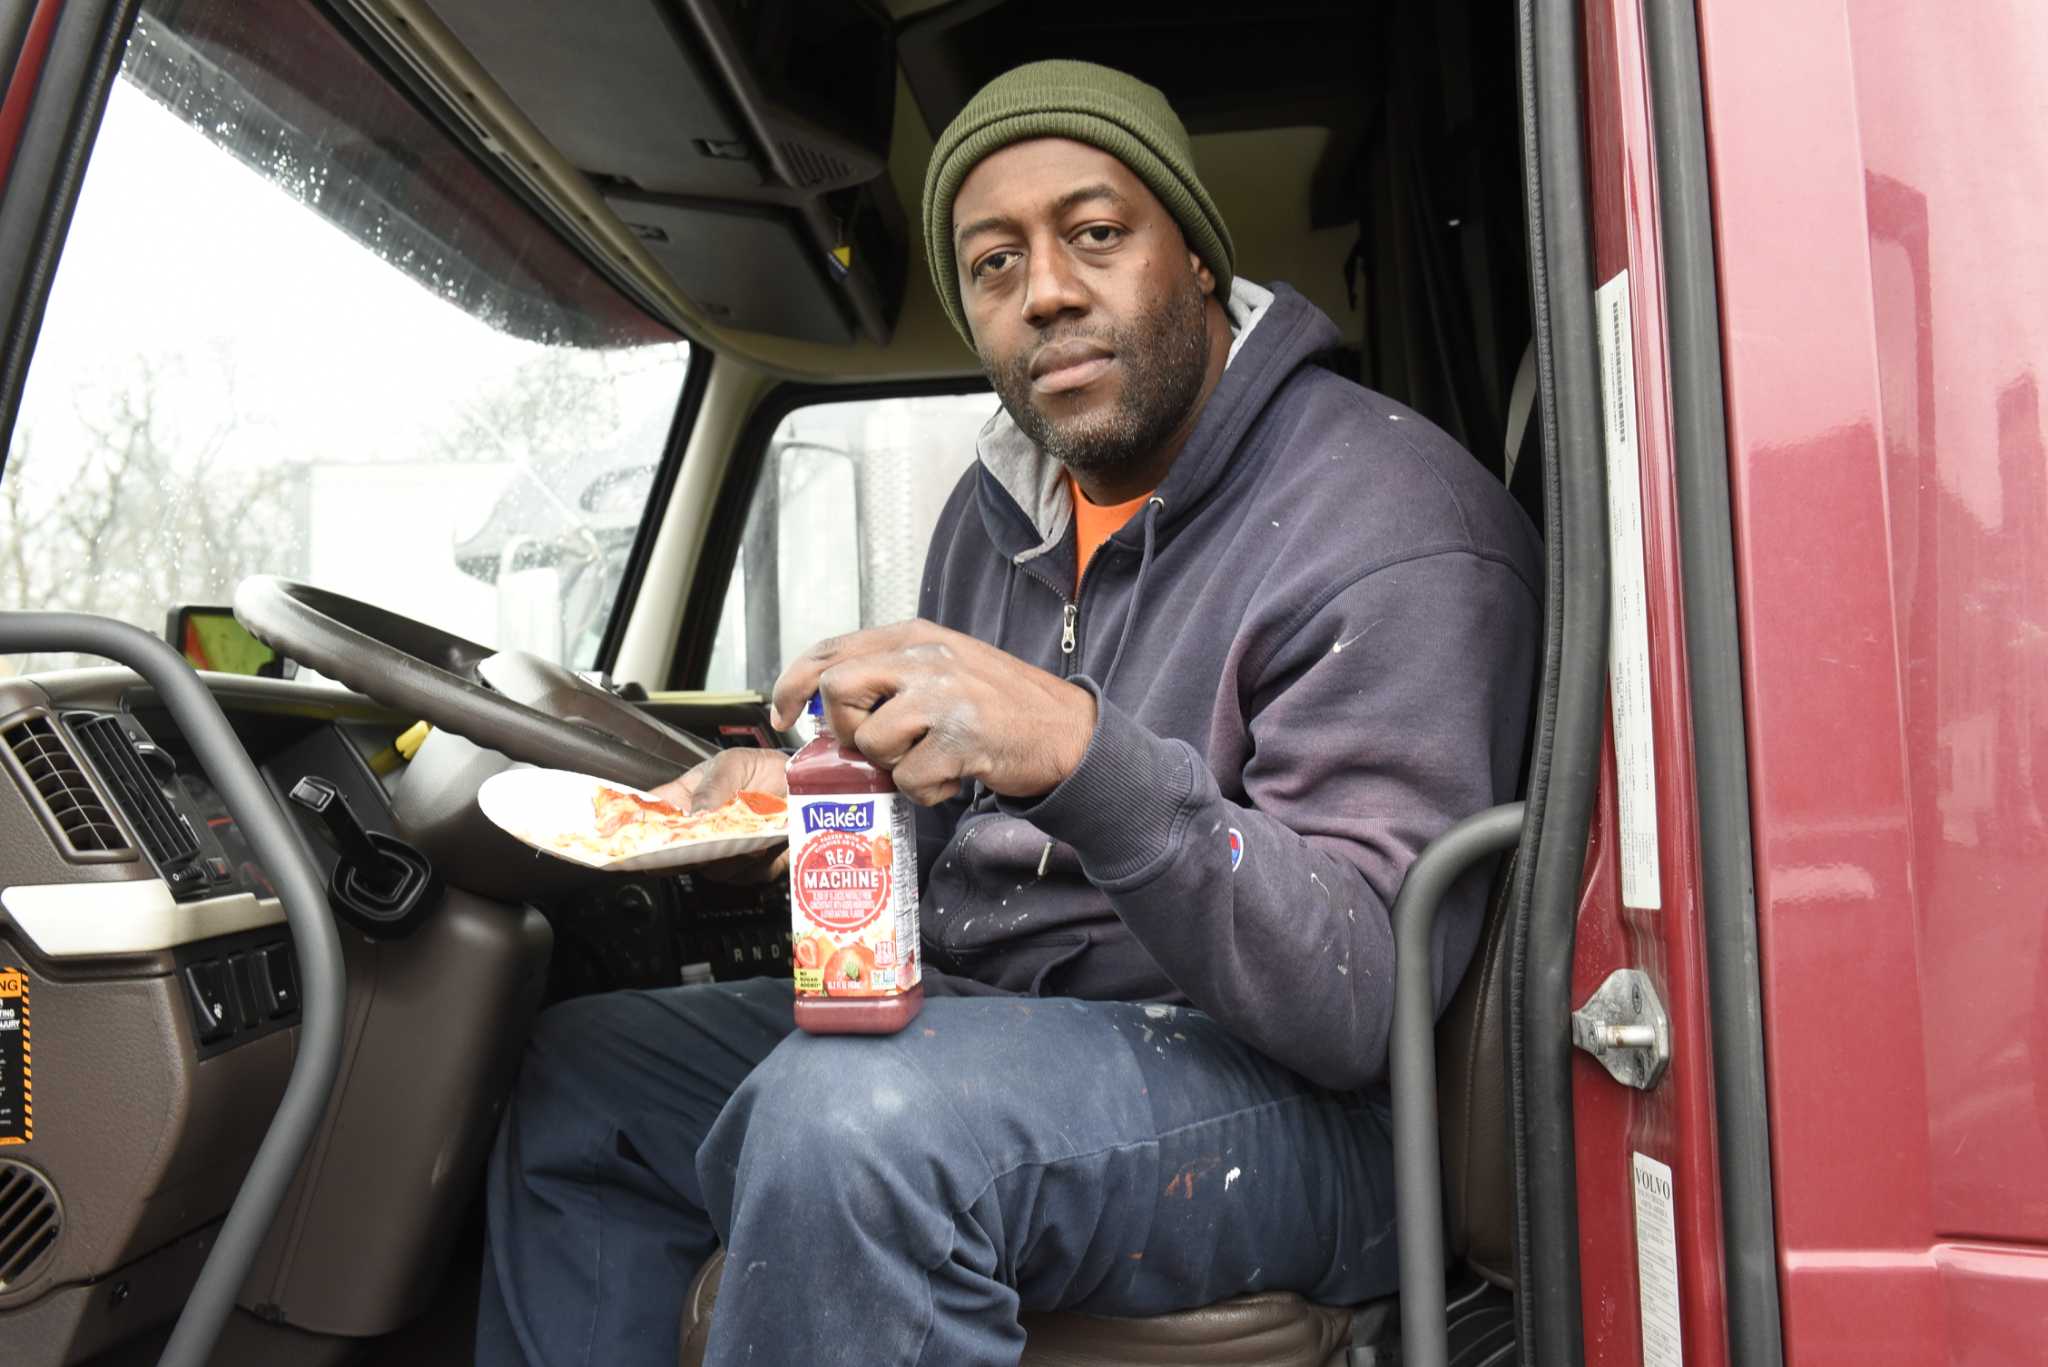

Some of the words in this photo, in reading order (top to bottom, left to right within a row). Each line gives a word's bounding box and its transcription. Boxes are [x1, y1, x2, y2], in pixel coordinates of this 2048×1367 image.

[809, 806, 868, 829] Naked
[824, 848, 855, 866] RED
[804, 870, 880, 889] MACHINE
[734, 948, 743, 962] R
[752, 946, 762, 960] N
[771, 944, 780, 958] D
[1635, 1167, 1670, 1200] VOLVO
